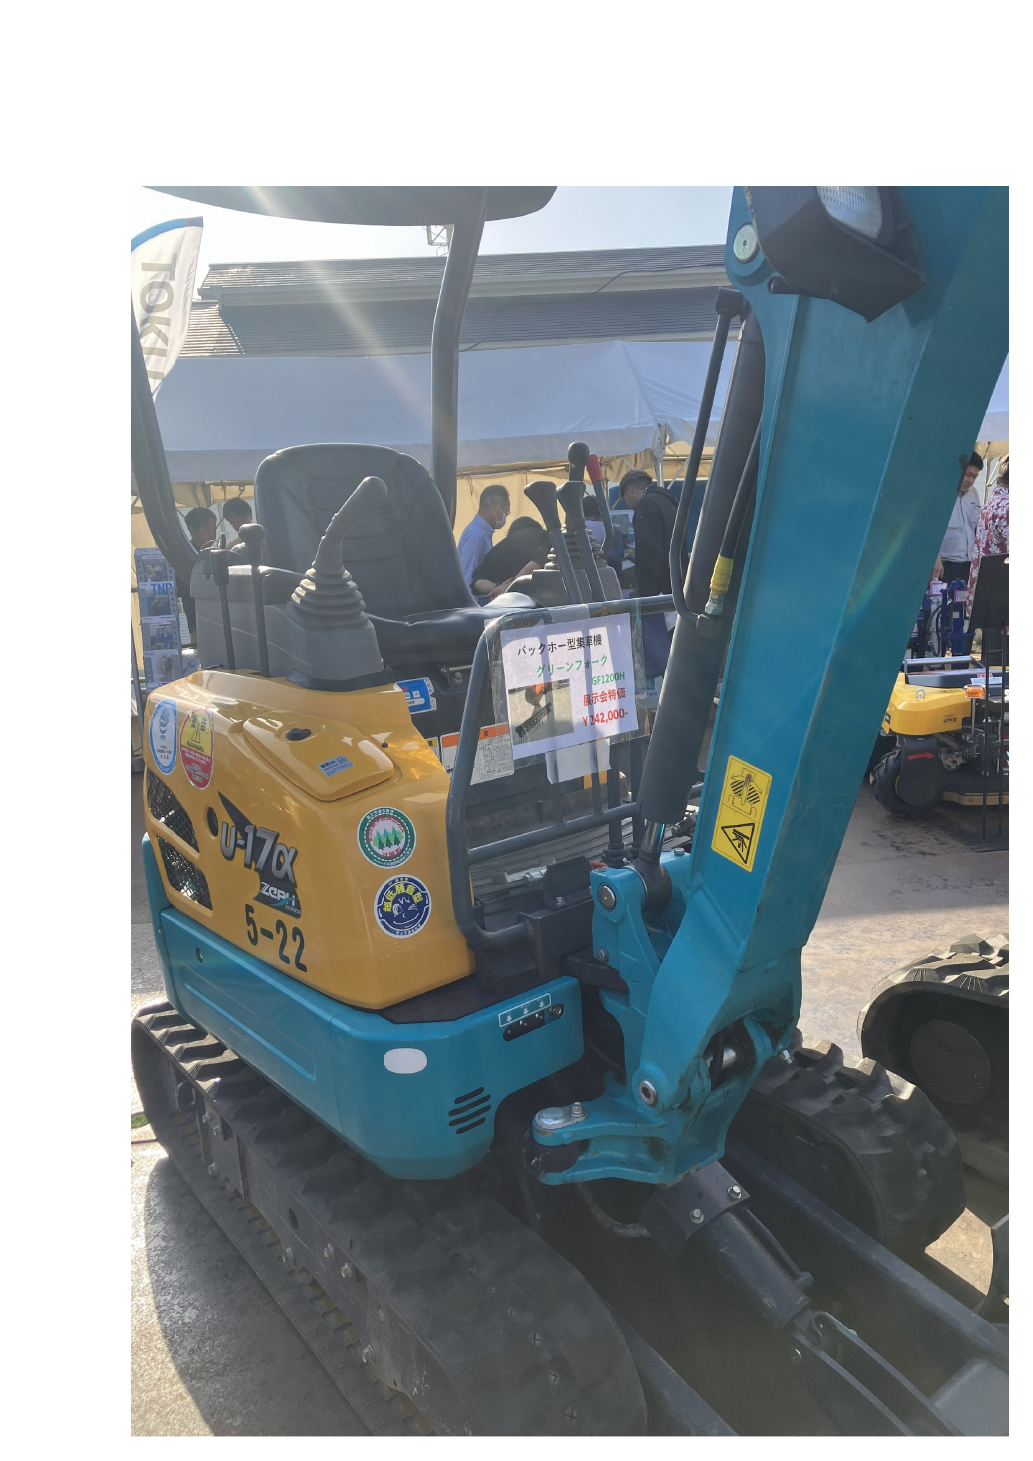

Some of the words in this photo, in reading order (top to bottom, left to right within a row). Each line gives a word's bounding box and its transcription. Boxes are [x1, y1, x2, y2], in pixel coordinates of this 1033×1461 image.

[537, 655, 608, 678] グリーンフォーク
[592, 672, 626, 686] GF1200H
[583, 687, 627, 706] 展示会特価
[245, 904, 308, 972] 5-22
